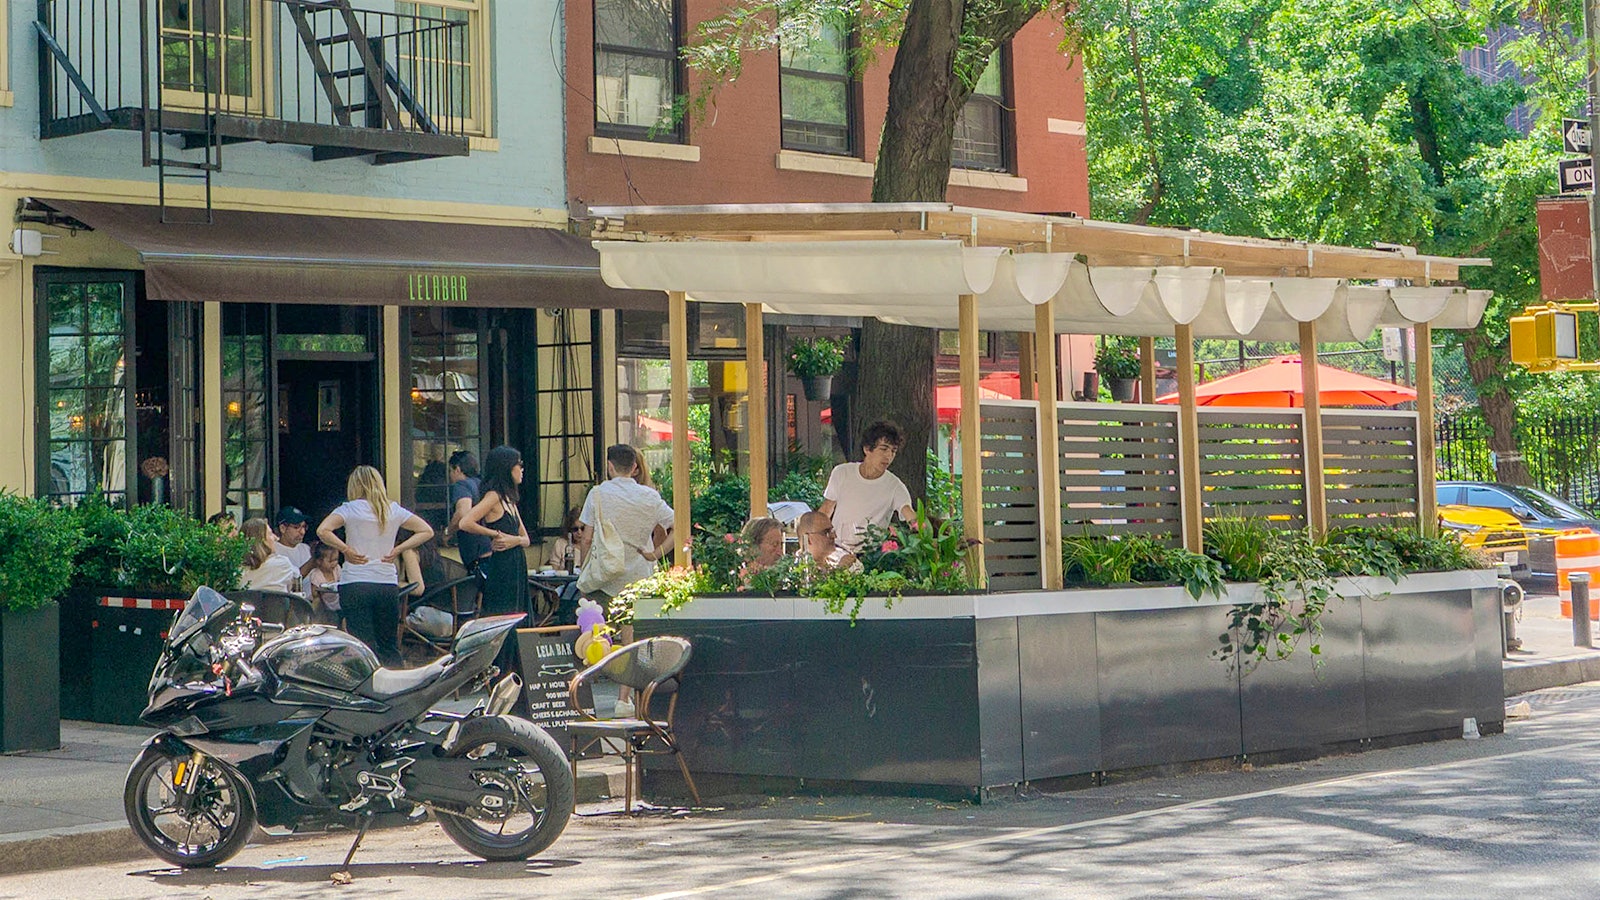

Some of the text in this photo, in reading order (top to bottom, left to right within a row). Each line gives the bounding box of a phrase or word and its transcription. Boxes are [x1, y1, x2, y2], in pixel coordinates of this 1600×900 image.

[409, 274, 468, 301] LELABAR
[535, 642, 573, 658] LELA BAR
[531, 700, 566, 710] CRAFT BEER
